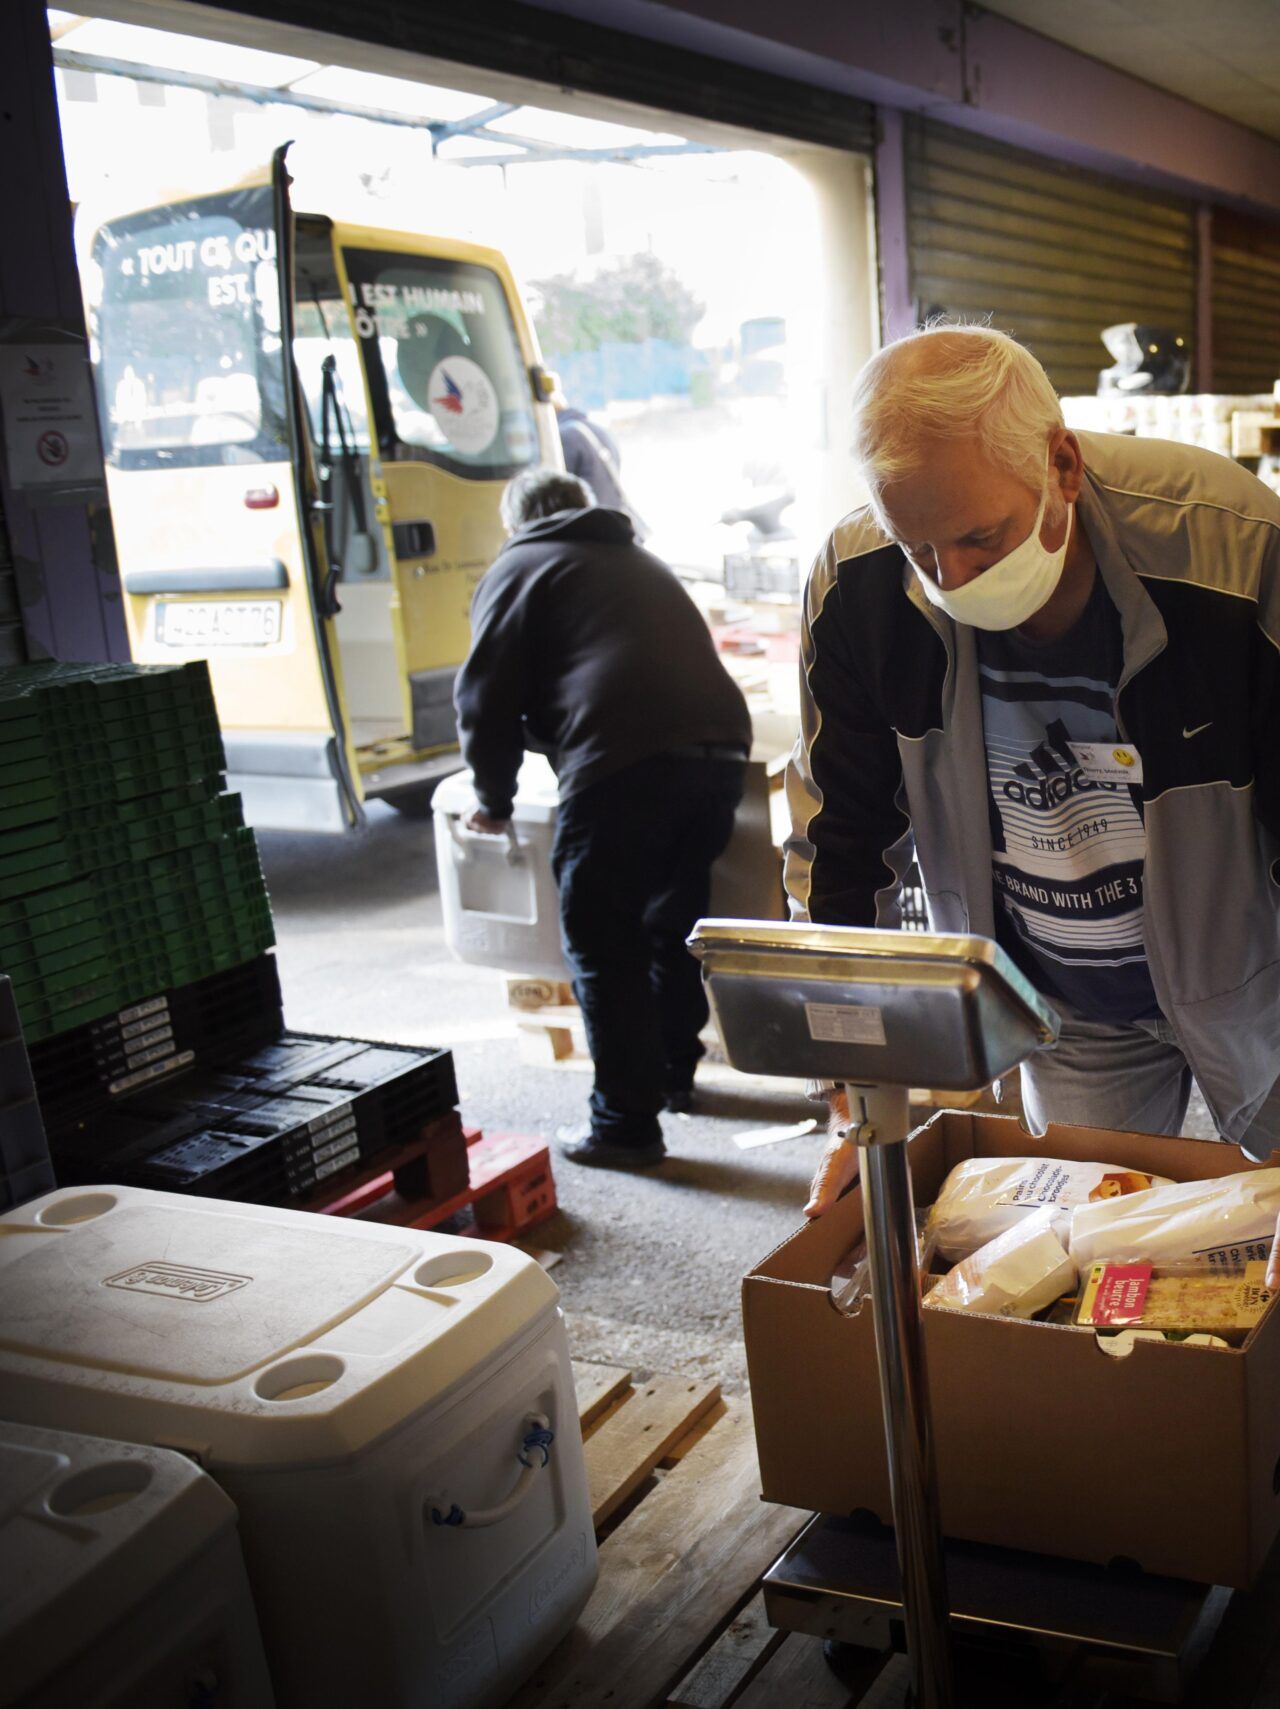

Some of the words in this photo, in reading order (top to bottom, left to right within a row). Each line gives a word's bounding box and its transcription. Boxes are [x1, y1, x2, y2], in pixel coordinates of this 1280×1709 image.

[137, 241, 196, 277] TOUT
[208, 273, 251, 306] EST
[360, 283, 398, 308] EST
[401, 285, 486, 315] HUMAIN
[1031, 833, 1075, 851] SINCE
[1077, 818, 1108, 840] 1949
[1005, 875, 1049, 904] BRAND
[1051, 891, 1093, 909] WITH
[1095, 879, 1126, 906] THE
[1127, 877, 1138, 894] 3
[1013, 1179, 1029, 1201] Pains
[1028, 1162, 1050, 1191] chocolat
[1109, 1279, 1130, 1307] beurre
[1124, 1278, 1145, 1308] Jambon
